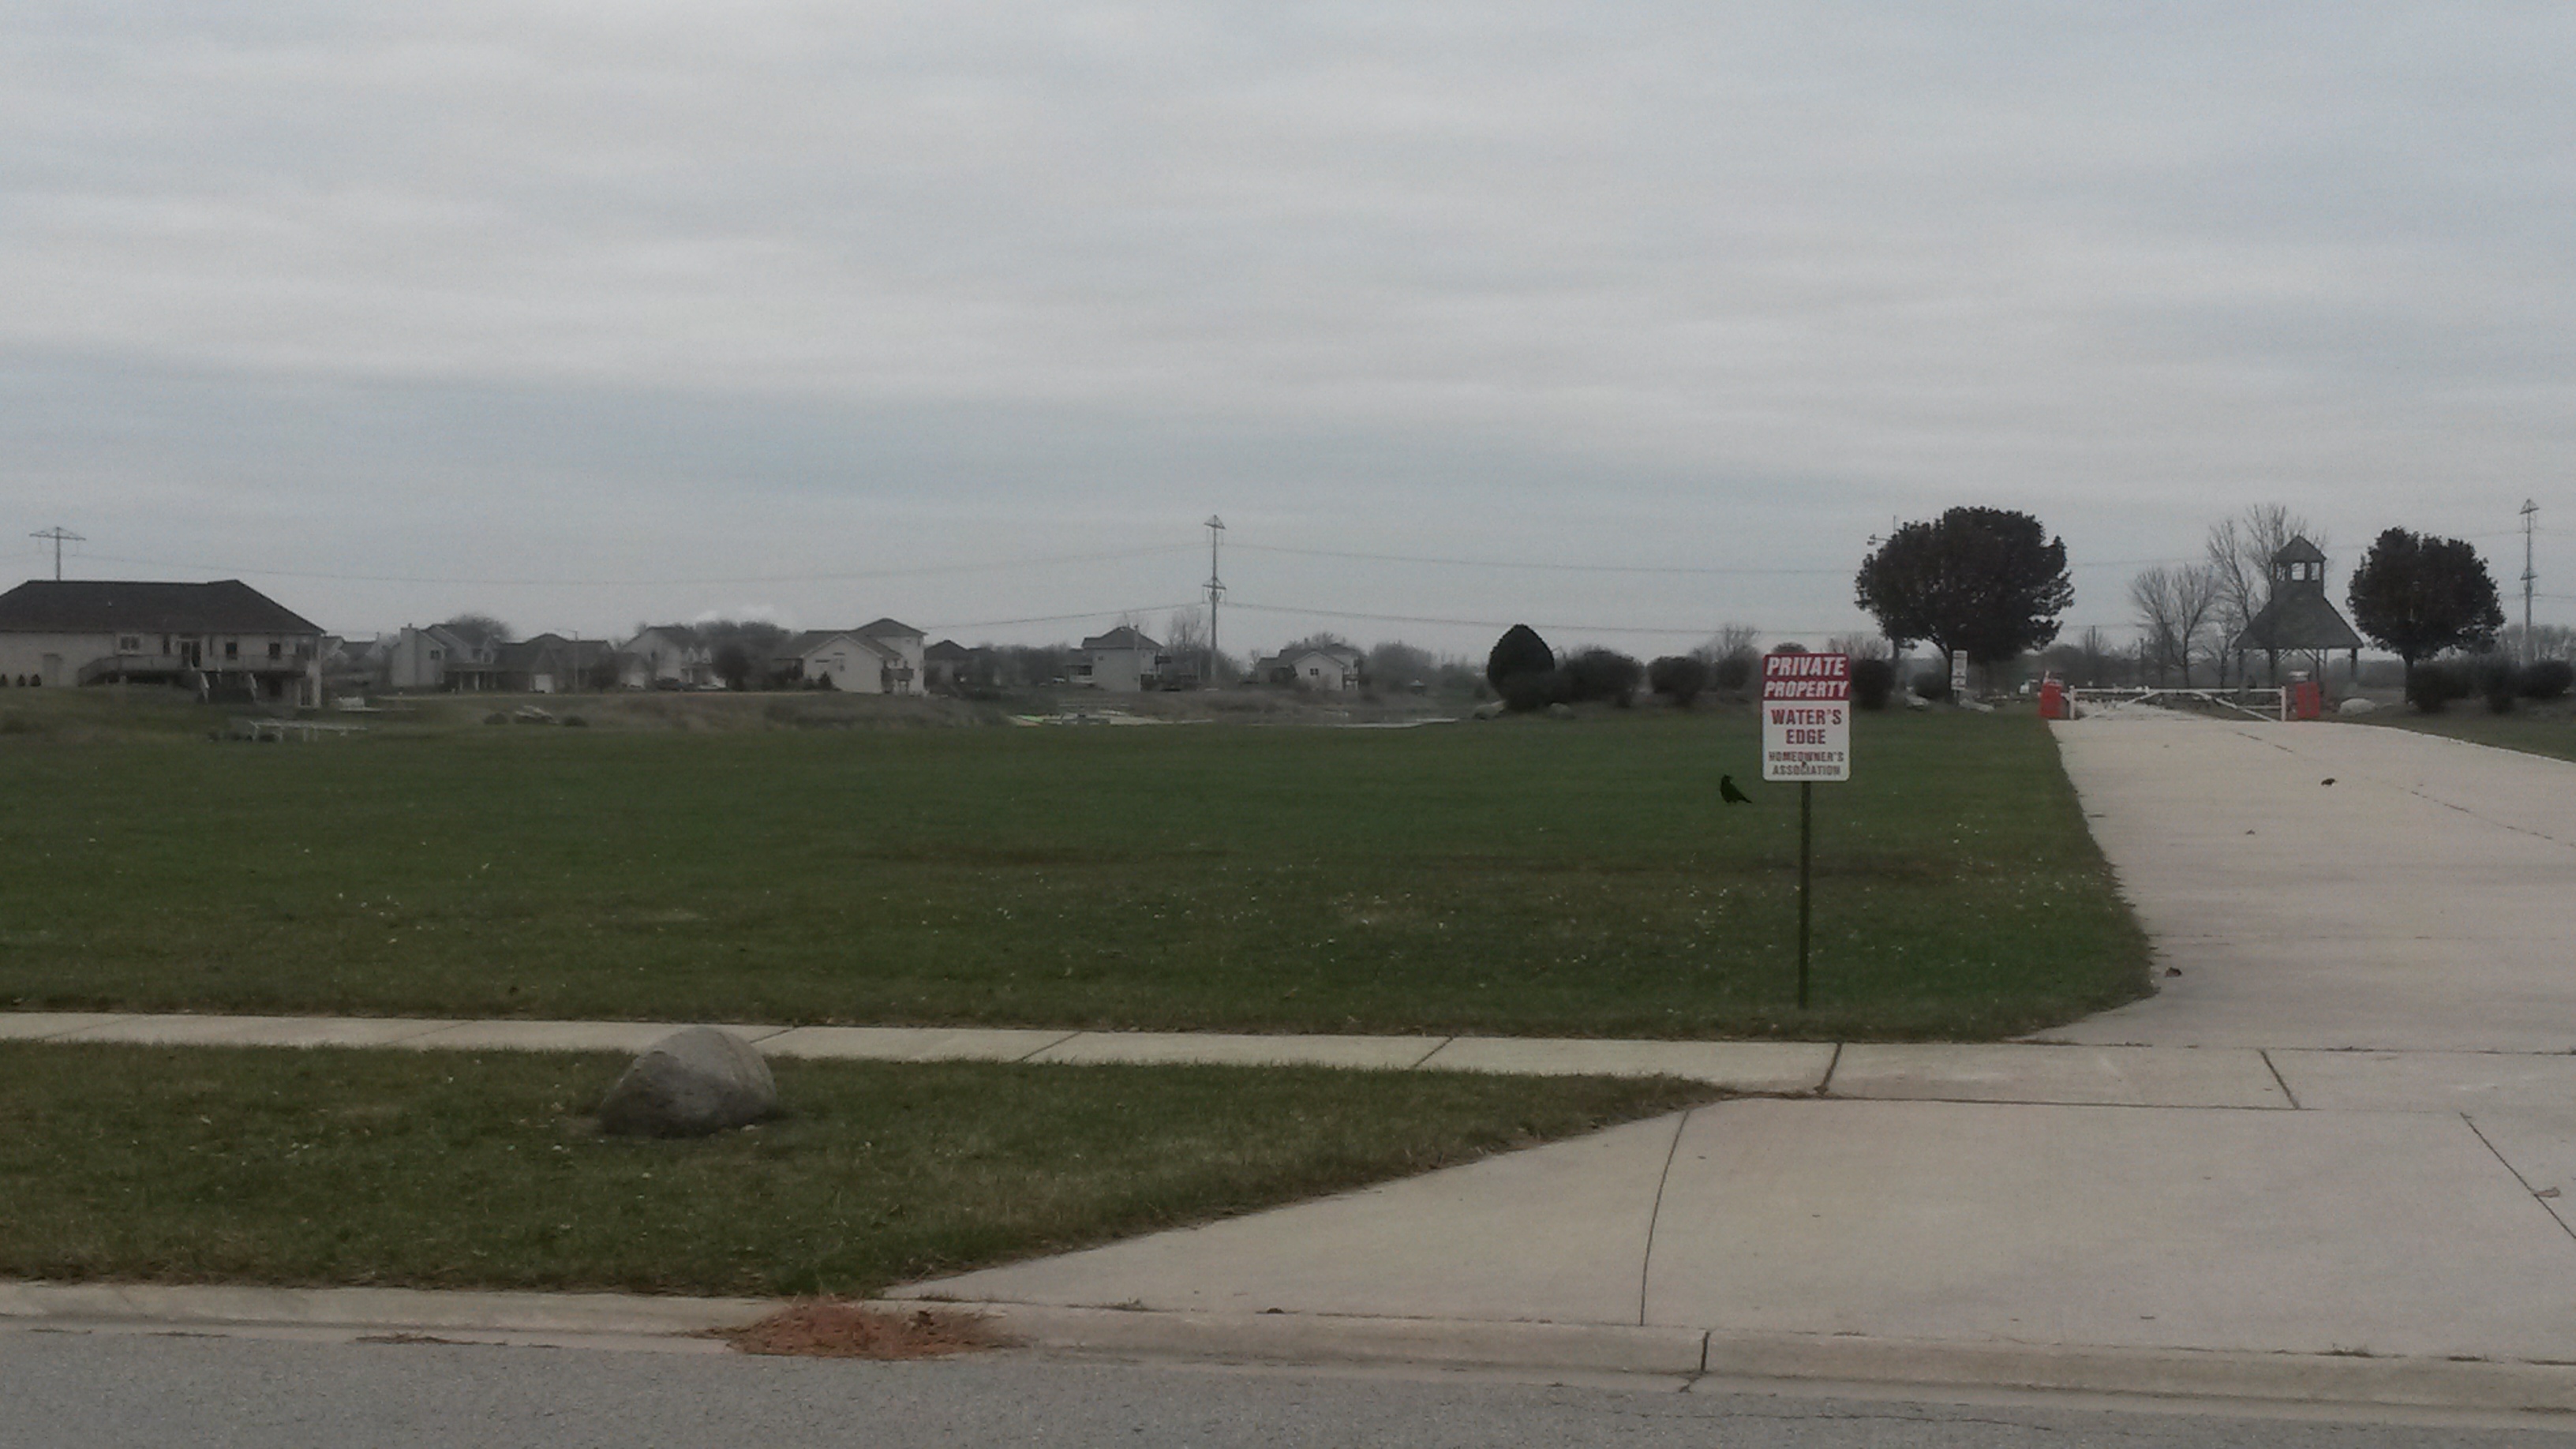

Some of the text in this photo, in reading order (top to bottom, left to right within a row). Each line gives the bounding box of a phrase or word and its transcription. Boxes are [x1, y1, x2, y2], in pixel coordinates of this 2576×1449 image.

[1766, 657, 1847, 676] PRIVATE
[1764, 680, 1849, 698] PROPERTY
[1771, 709, 1843, 725] WATER'S
[1786, 729, 1825, 745] EDGE
[1769, 751, 1844, 762] HOMEOWNER'S
[1773, 765, 1841, 776] ASSOCIATION
